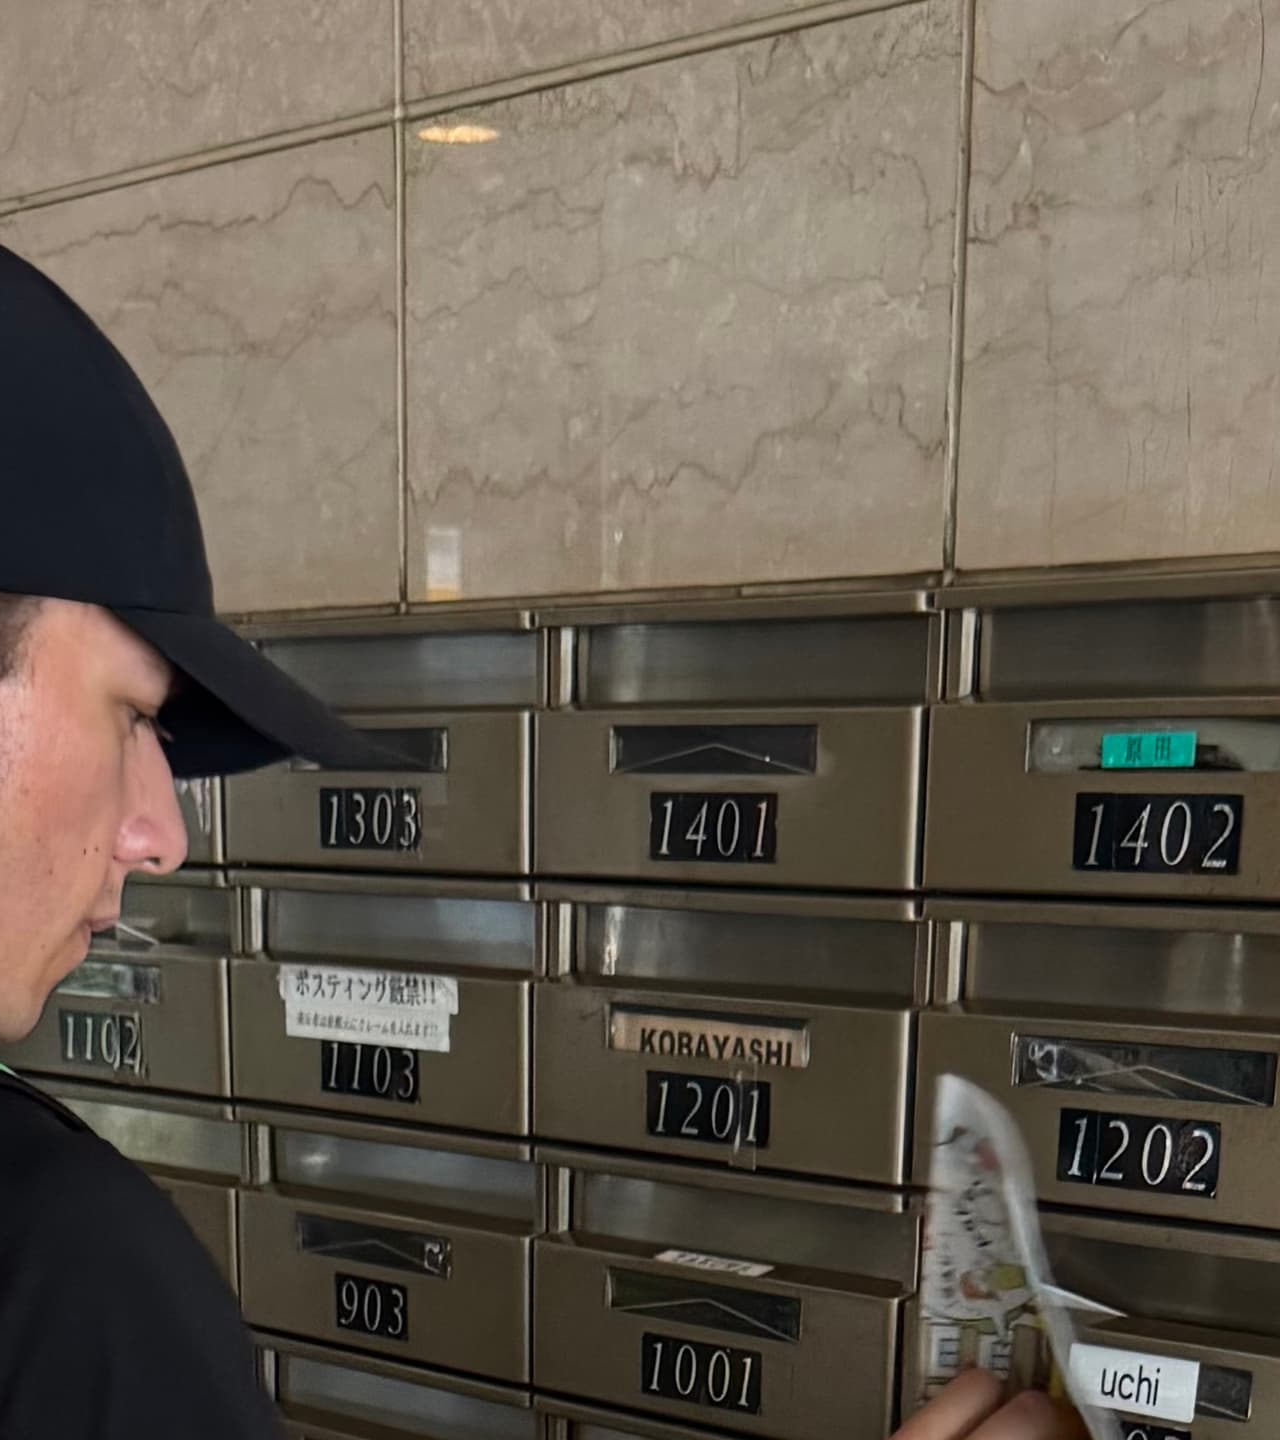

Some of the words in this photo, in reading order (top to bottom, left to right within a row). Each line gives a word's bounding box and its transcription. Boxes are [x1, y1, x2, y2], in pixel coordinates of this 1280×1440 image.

[327, 793, 419, 848] 1303
[655, 798, 768, 860] 1401
[1082, 800, 1237, 869] 1402
[66, 1015, 138, 1065] 1102
[639, 1027, 793, 1067] KOBAYASHI
[328, 1042, 415, 1098] 1103
[655, 1080, 760, 1142] 1201
[1066, 1116, 1215, 1194] 1202
[339, 1282, 404, 1336] 903
[648, 1339, 754, 1408] 1001
[1099, 1363, 1160, 1408] uchi
